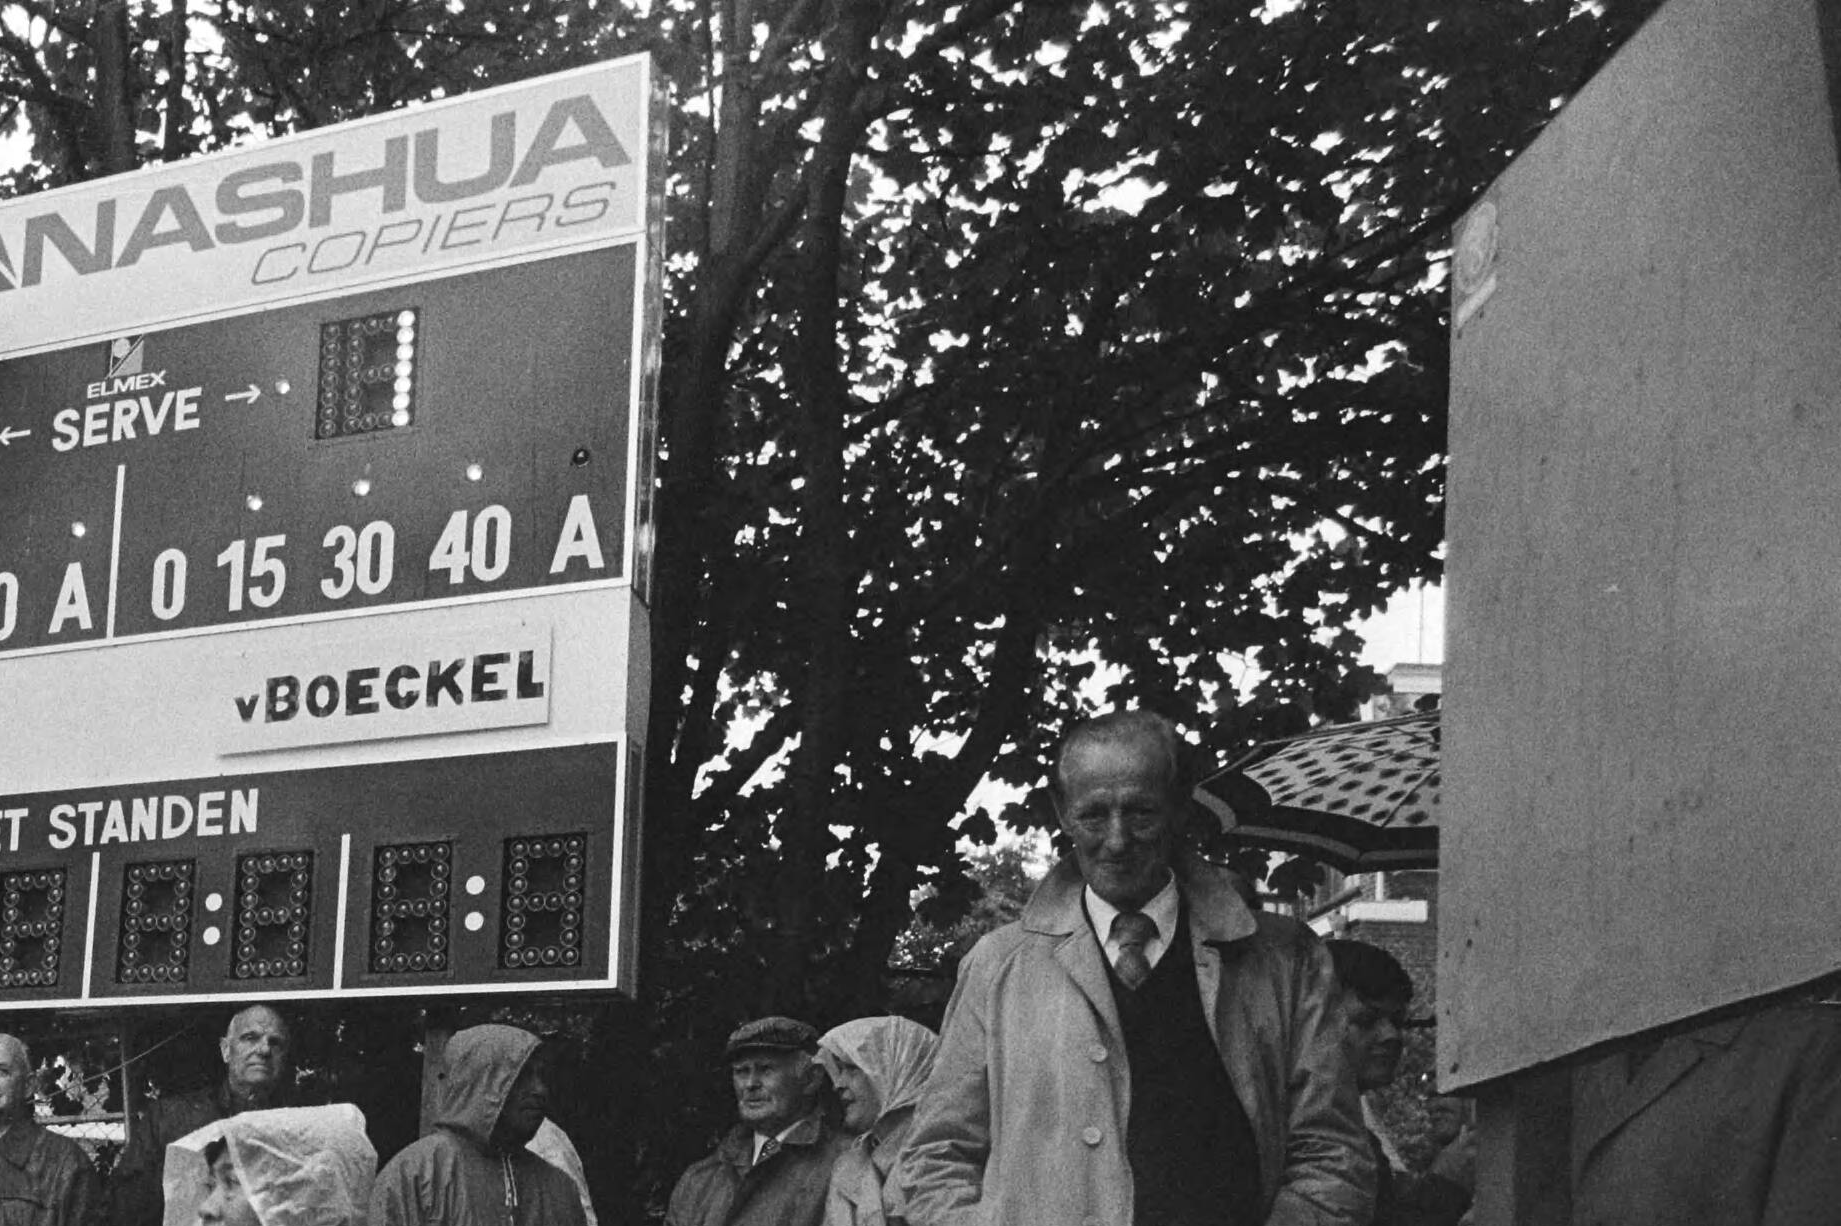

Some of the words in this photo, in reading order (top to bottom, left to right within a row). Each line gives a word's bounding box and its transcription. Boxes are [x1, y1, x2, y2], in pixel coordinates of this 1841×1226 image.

[20, 93, 633, 288] NASHUA
[251, 181, 617, 285] COPIERS
[52, 386, 202, 451] SERVE
[86, 370, 167, 399] ELMEX
[151, 548, 187, 620] 0
[216, 534, 287, 612] 15
[320, 520, 395, 600] 30
[429, 504, 512, 585] 40
[549, 494, 605, 574] A
[48, 561, 93, 635] A
[48, 788, 259, 850] STANDEN
